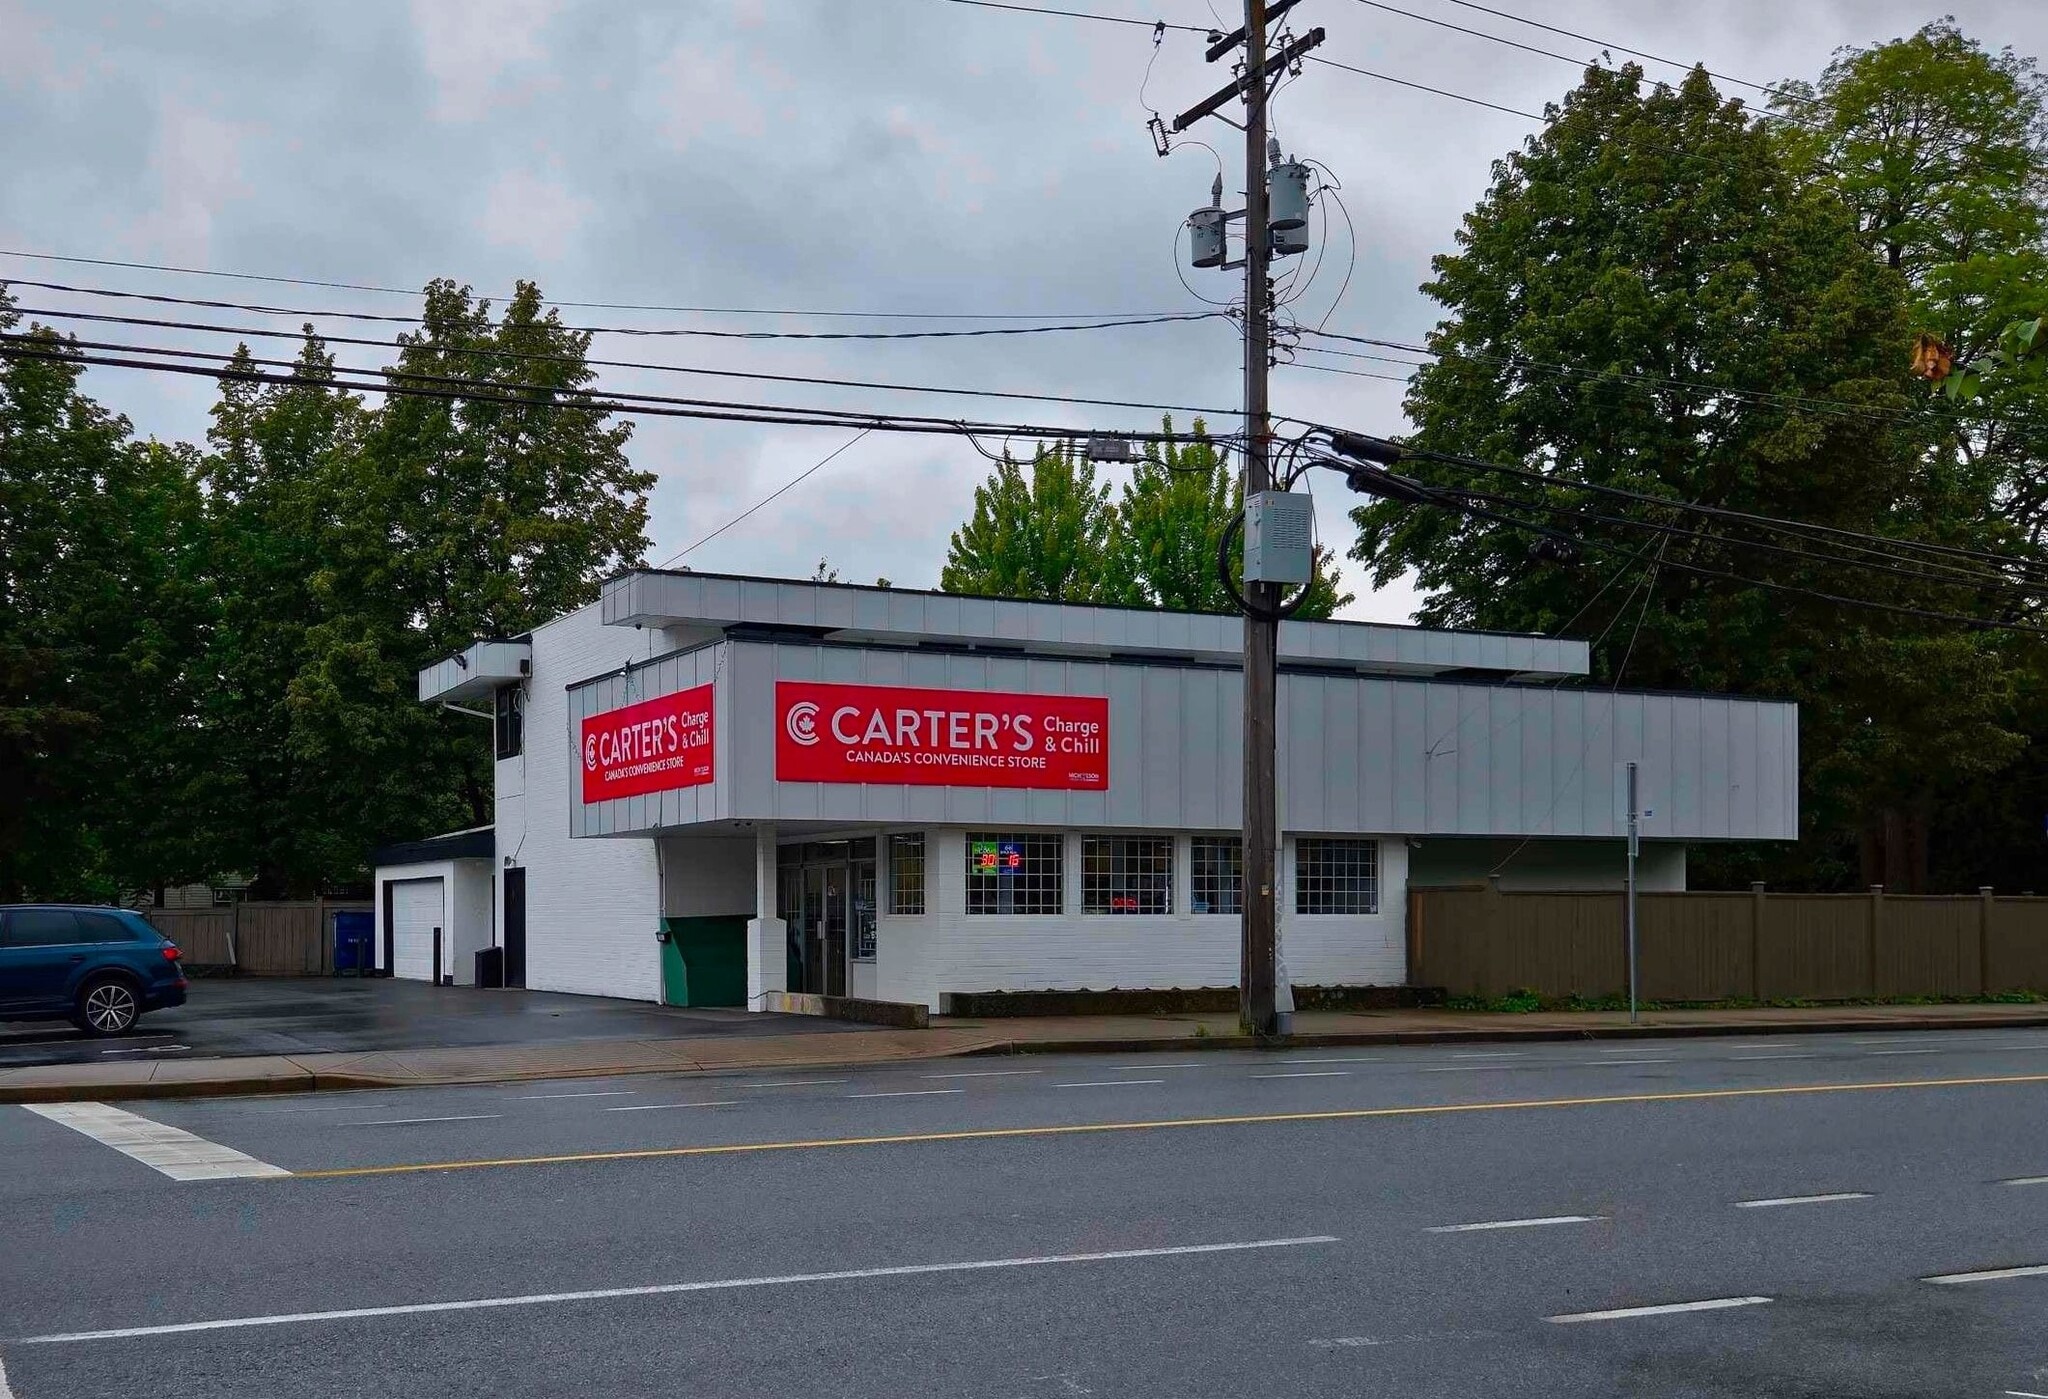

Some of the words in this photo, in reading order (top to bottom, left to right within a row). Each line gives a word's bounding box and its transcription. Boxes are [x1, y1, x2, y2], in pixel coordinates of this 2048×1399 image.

[681, 711, 709, 729] Charge
[831, 706, 1034, 751] CARTER'S
[1043, 715, 1099, 737] Charge
[599, 714, 678, 767] CARTER'S
[682, 733, 689, 749] &
[689, 728, 710, 748] Chill
[1045, 736, 1057, 752] &
[1060, 737, 1100, 754] Chill
[604, 767, 629, 782] CANADA'S
[628, 758, 666, 777] CONVENIENCE
[666, 755, 685, 771] STORE
[846, 750, 911, 764] CANADA'S
[914, 752, 1005, 768] CONVENIENCE
[1007, 755, 1047, 769] STORE
